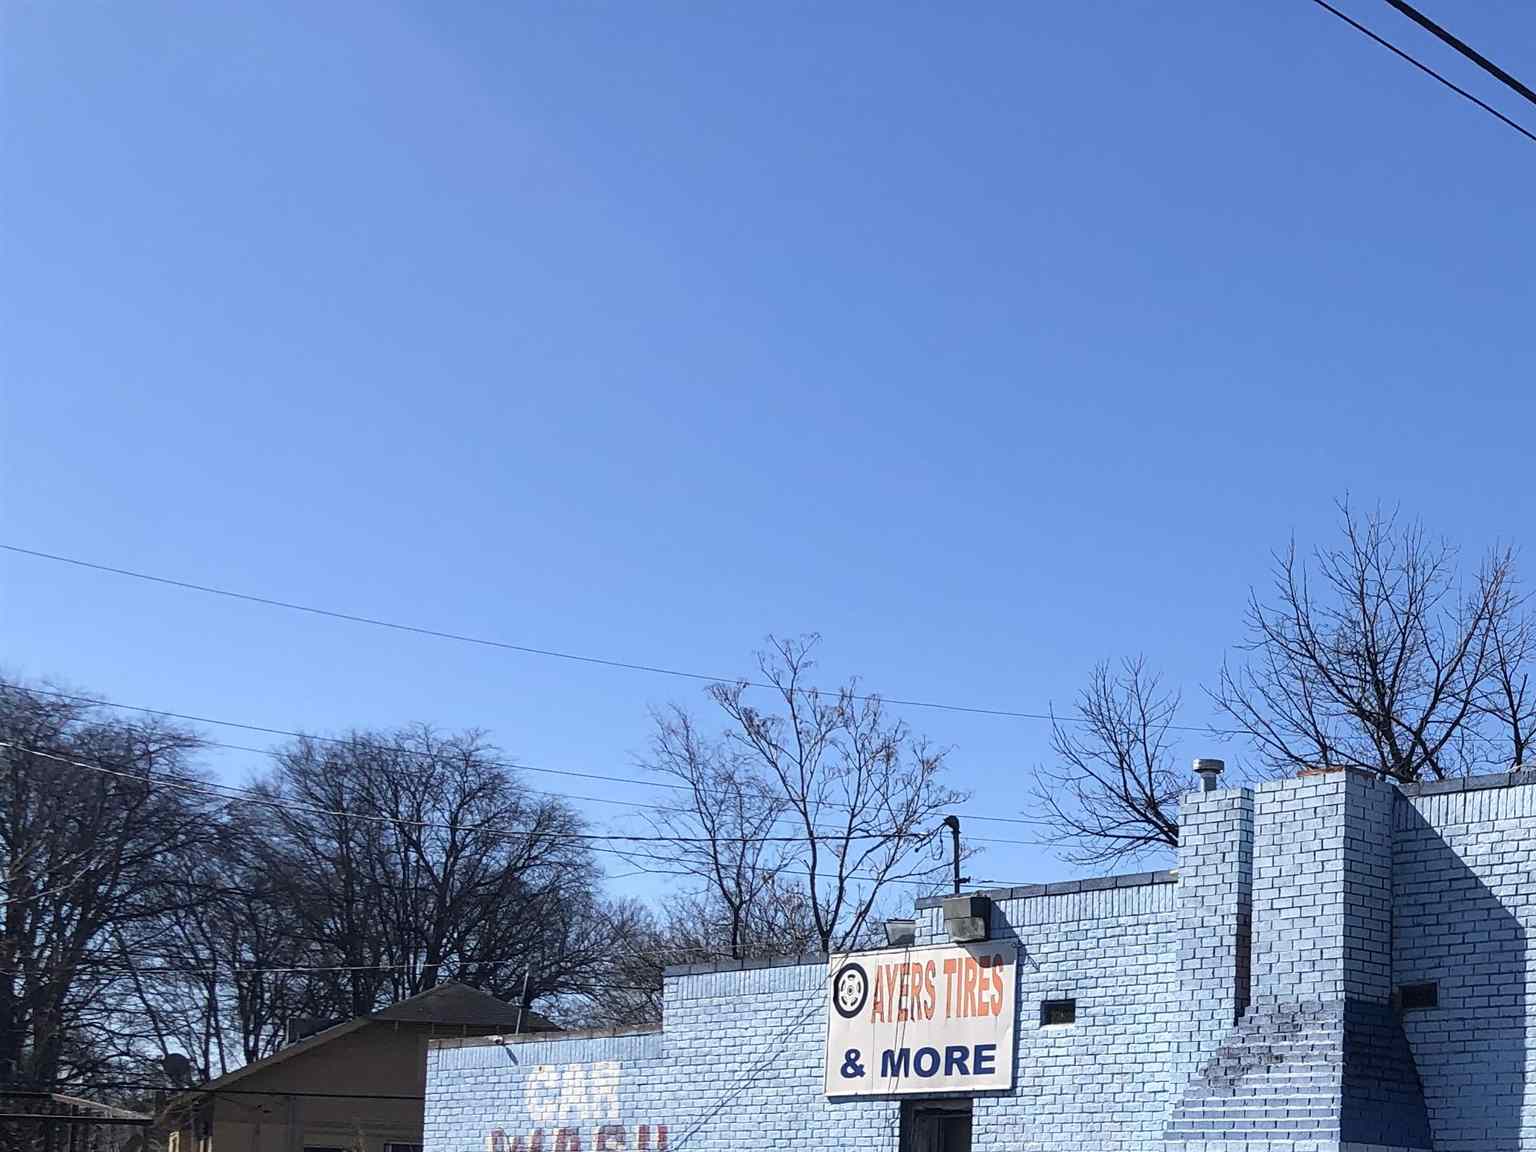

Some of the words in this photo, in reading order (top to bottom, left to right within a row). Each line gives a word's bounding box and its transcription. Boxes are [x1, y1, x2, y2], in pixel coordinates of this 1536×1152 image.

[871, 959, 936, 1024] AYERS
[943, 953, 1004, 1019] TIRES
[840, 1048, 865, 1079] &
[881, 1044, 997, 1078] MORE
[525, 1062, 623, 1121] CAR
